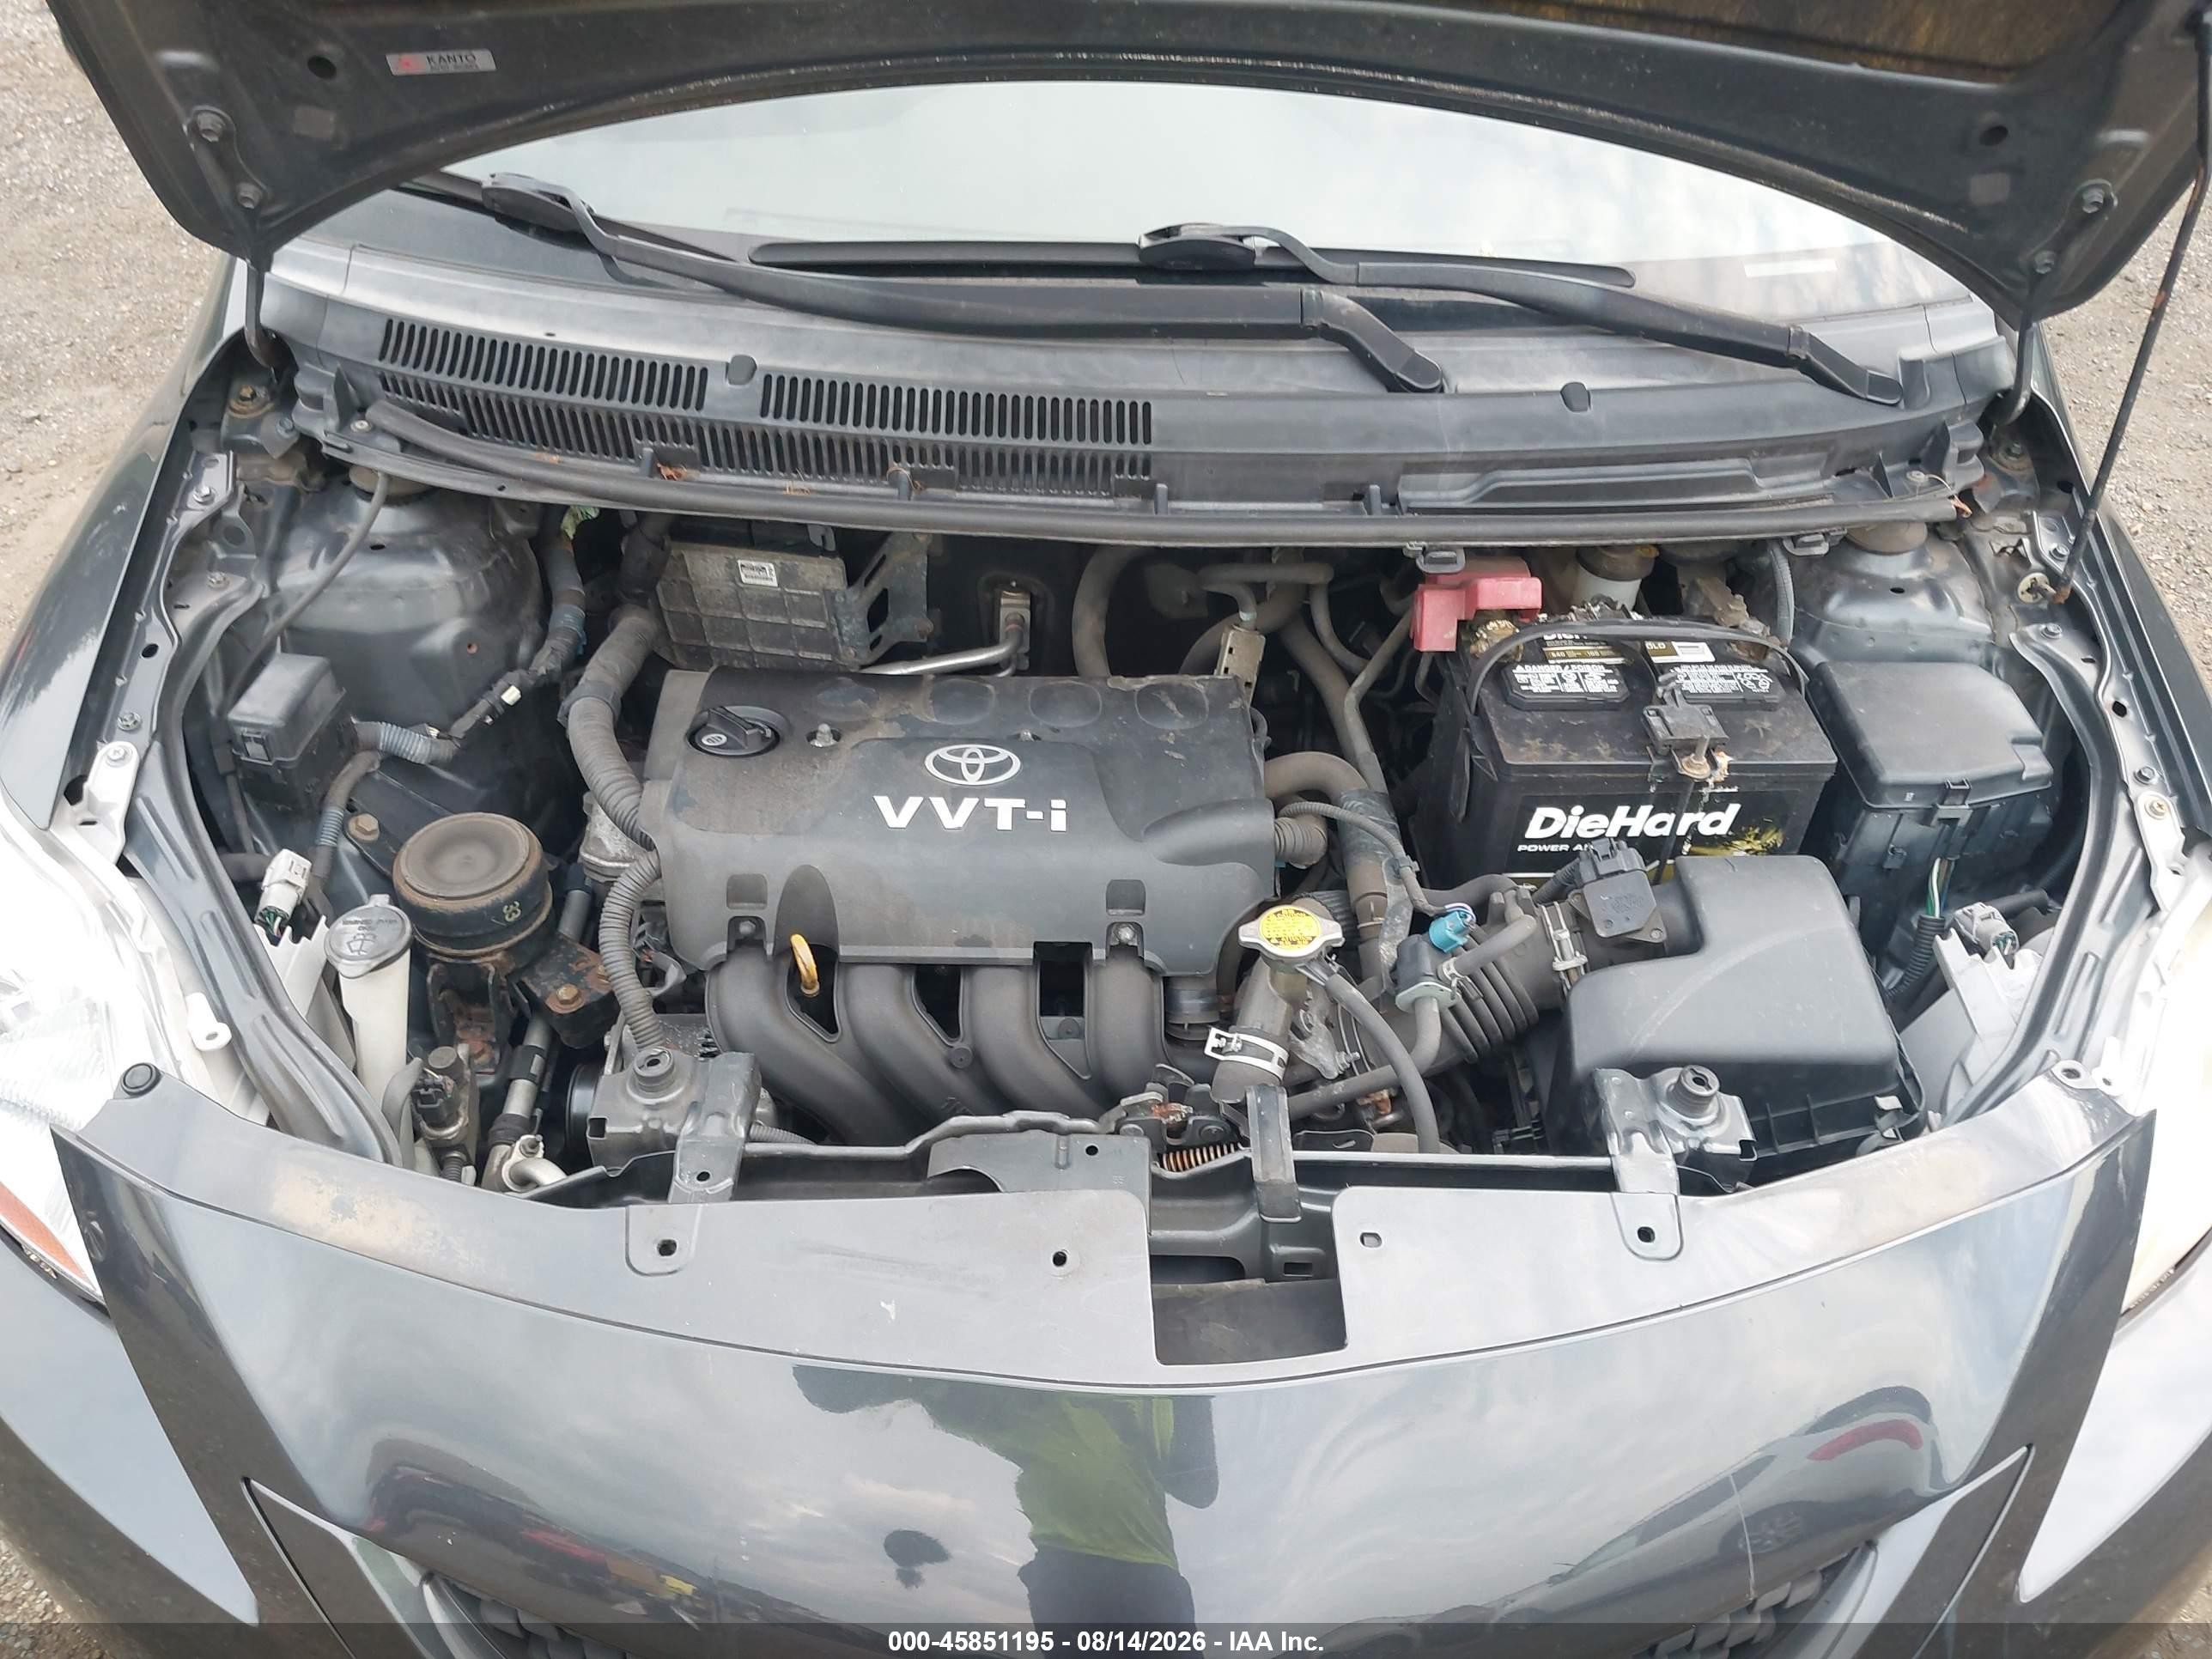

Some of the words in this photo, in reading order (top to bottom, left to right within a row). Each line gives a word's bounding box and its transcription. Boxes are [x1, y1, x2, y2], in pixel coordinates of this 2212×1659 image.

[427, 54, 477, 65] KANTO
[872, 795, 1066, 832] VVT-i
[1525, 804, 1741, 839] DieHard
